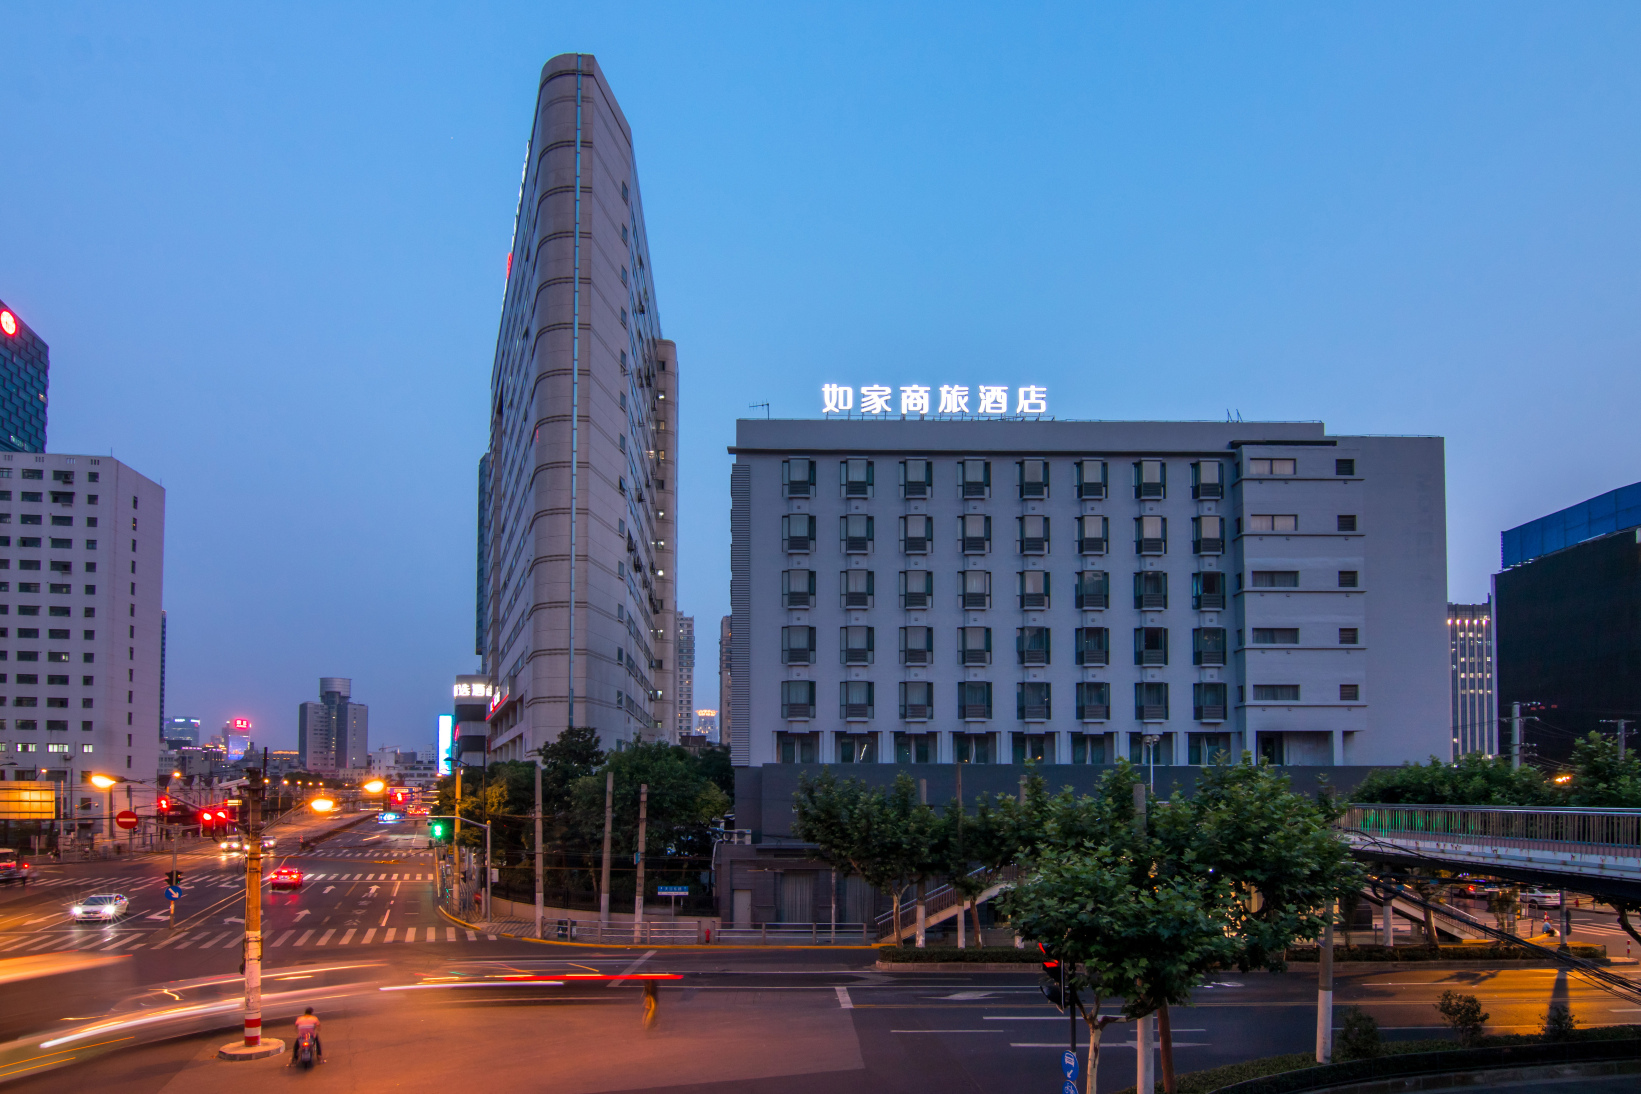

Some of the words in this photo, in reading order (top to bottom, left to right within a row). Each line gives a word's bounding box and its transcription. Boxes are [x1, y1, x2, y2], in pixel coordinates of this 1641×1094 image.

[822, 384, 1047, 414] 如家商旅酒店
